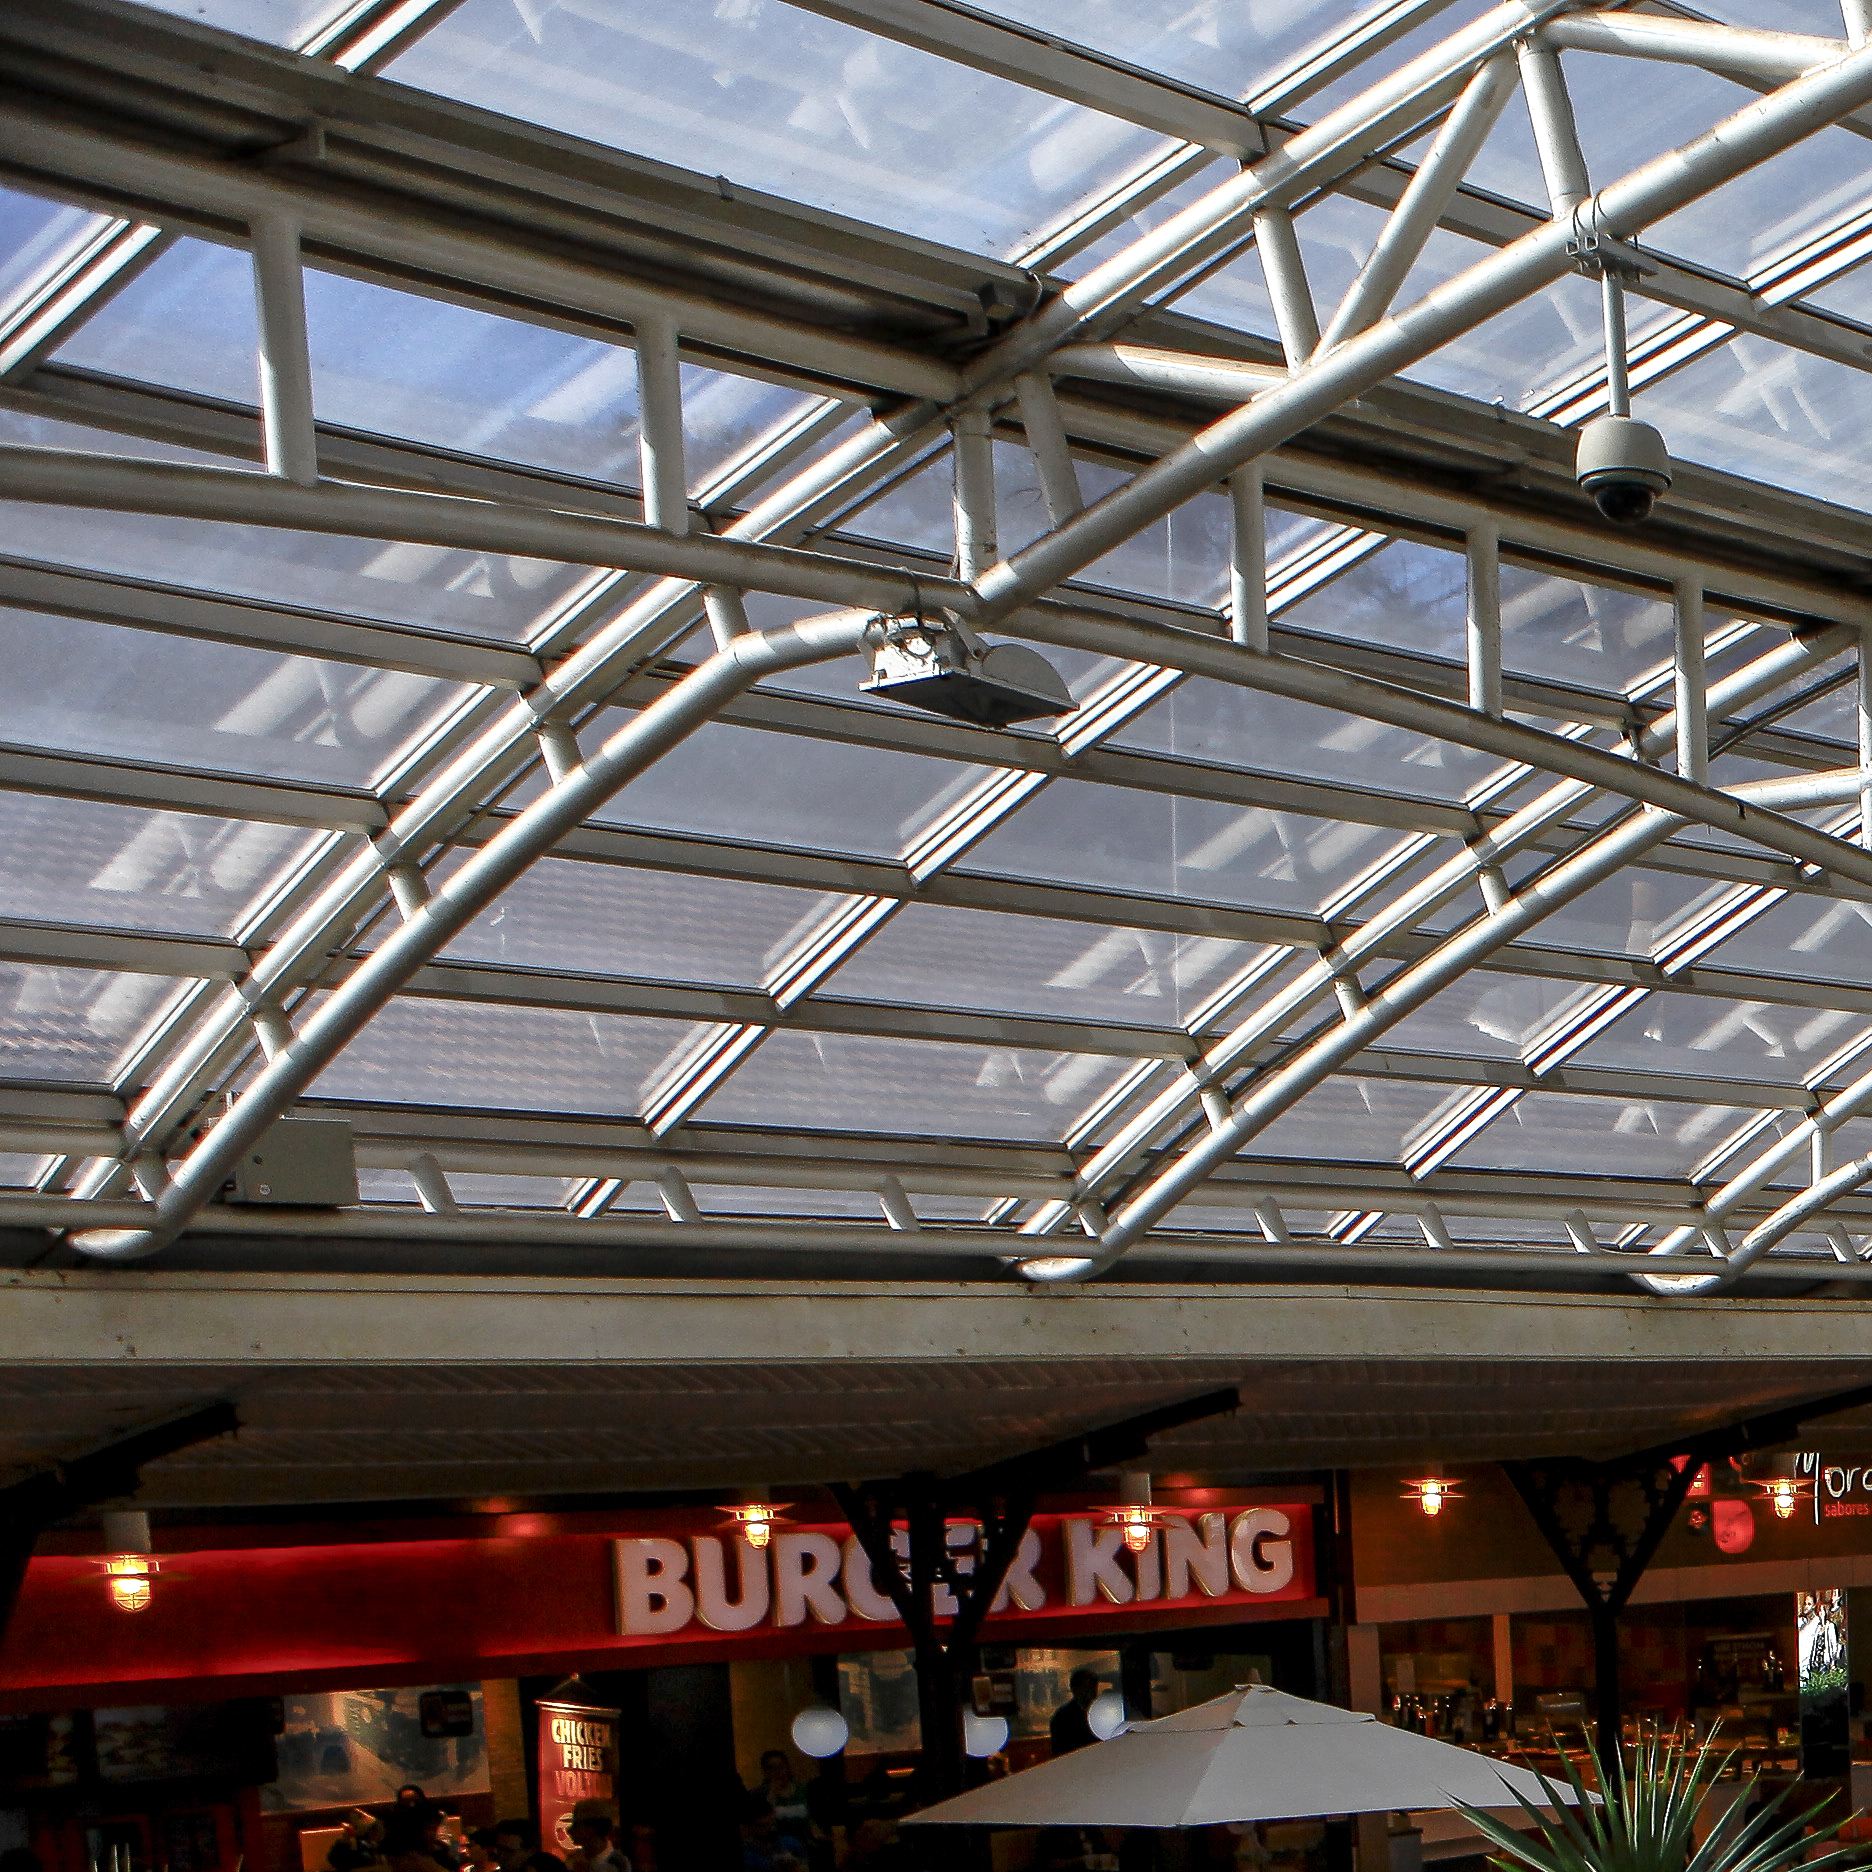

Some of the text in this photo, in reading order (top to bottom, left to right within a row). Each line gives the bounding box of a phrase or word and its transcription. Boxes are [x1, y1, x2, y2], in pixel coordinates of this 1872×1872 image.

[1825, 1501, 1869, 1517] sabores
[1065, 1507, 1292, 1605] KING
[563, 1744, 604, 1772] FRIES
